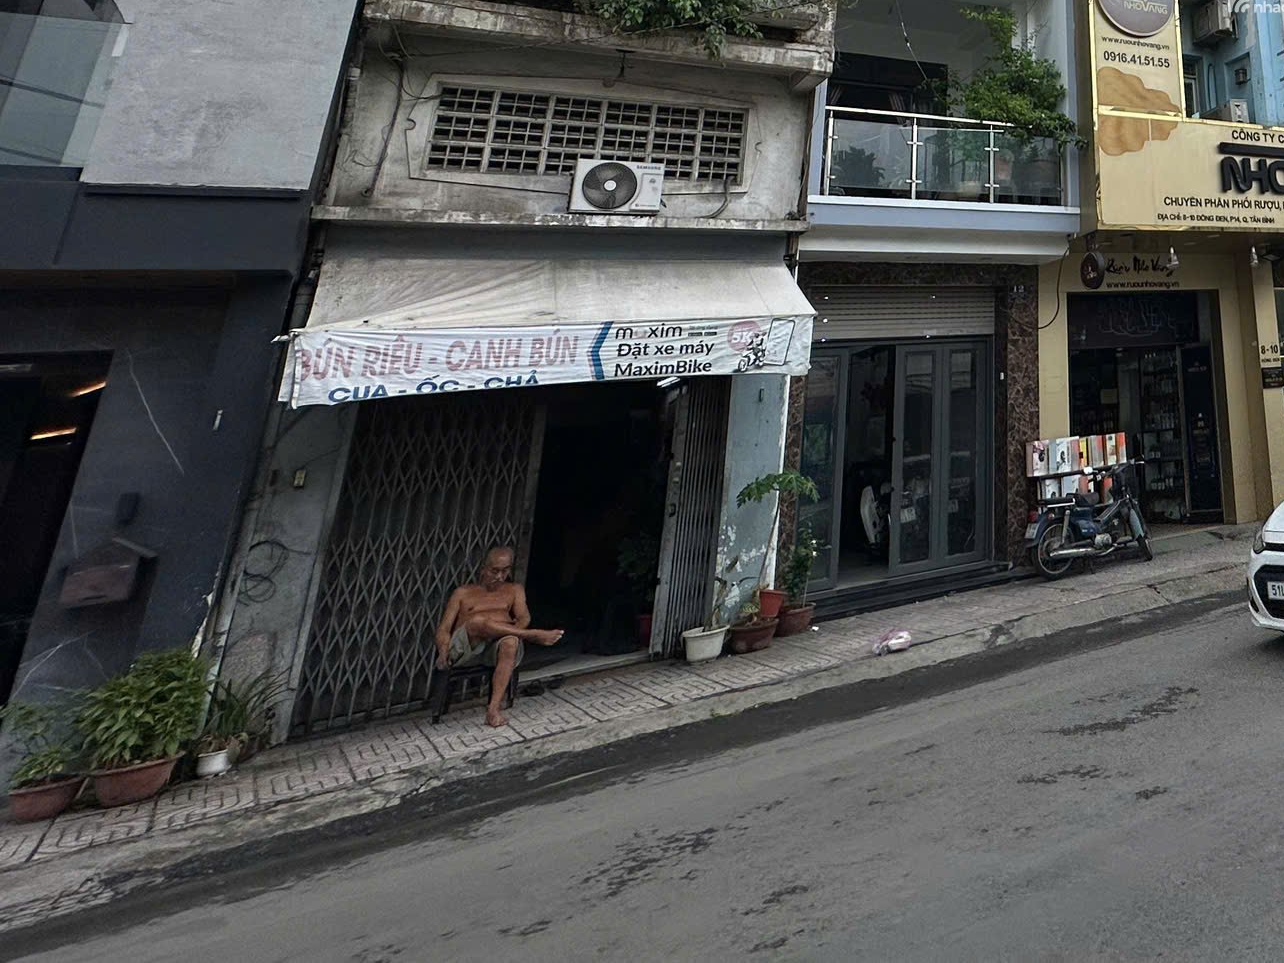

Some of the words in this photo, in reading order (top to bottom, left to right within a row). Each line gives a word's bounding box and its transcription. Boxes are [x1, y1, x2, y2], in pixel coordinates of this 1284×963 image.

[1103, 50, 1170, 68] 0916.41.51.55
[1231, 129, 1261, 142] CÔNG
[1262, 133, 1275, 143] TY
[1164, 196, 1202, 208] CHUYÊN
[615, 323, 683, 340] mxim
[298, 337, 355, 382] BÚN
[361, 334, 423, 377] RIÊU
[445, 339, 522, 372] CANH
[528, 327, 579, 367] BÚN
[617, 342, 650, 359] Đặt
[653, 345, 675, 356] xe
[679, 340, 715, 356] máy
[1260, 344, 1278, 354] 8-10
[614, 359, 713, 377] MaximBike
[328, 384, 389, 403] CUA
[416, 374, 460, 393] ỐC
